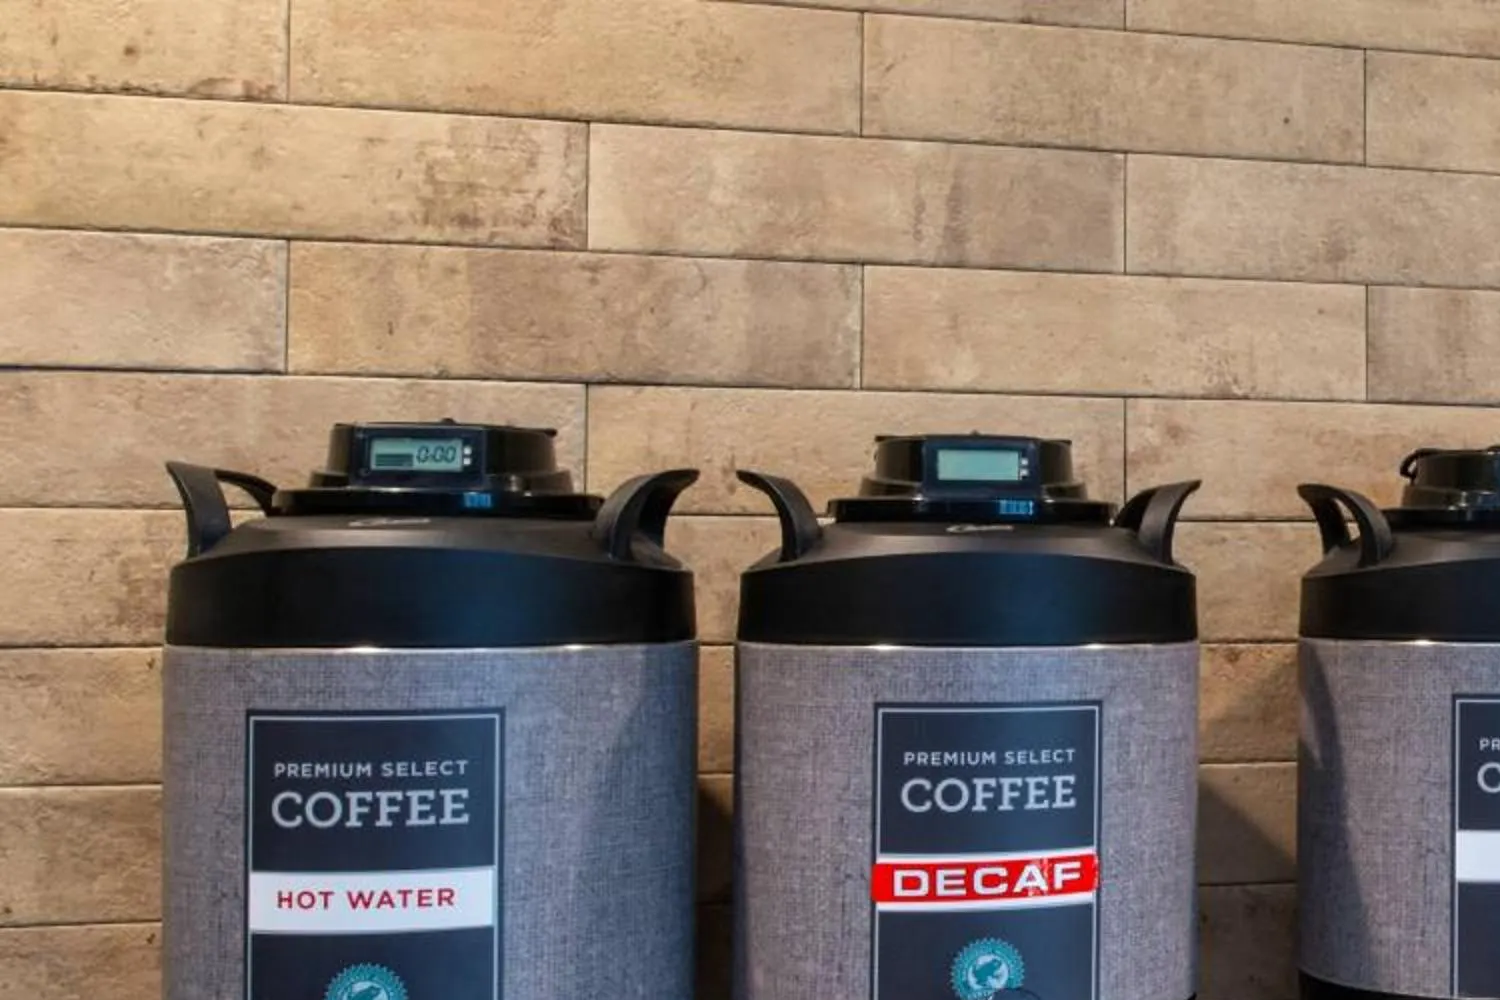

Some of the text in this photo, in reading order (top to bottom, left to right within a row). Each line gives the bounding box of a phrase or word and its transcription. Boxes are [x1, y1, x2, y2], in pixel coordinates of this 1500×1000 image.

[274, 760, 469, 778] PREMIUM SELECT
[903, 749, 1076, 766] PREMIUM SELECT
[271, 788, 470, 828] COFFEE
[901, 774, 1077, 813] COFFEE
[893, 862, 1081, 897] DECAF
[277, 887, 456, 910] HOT WATER
